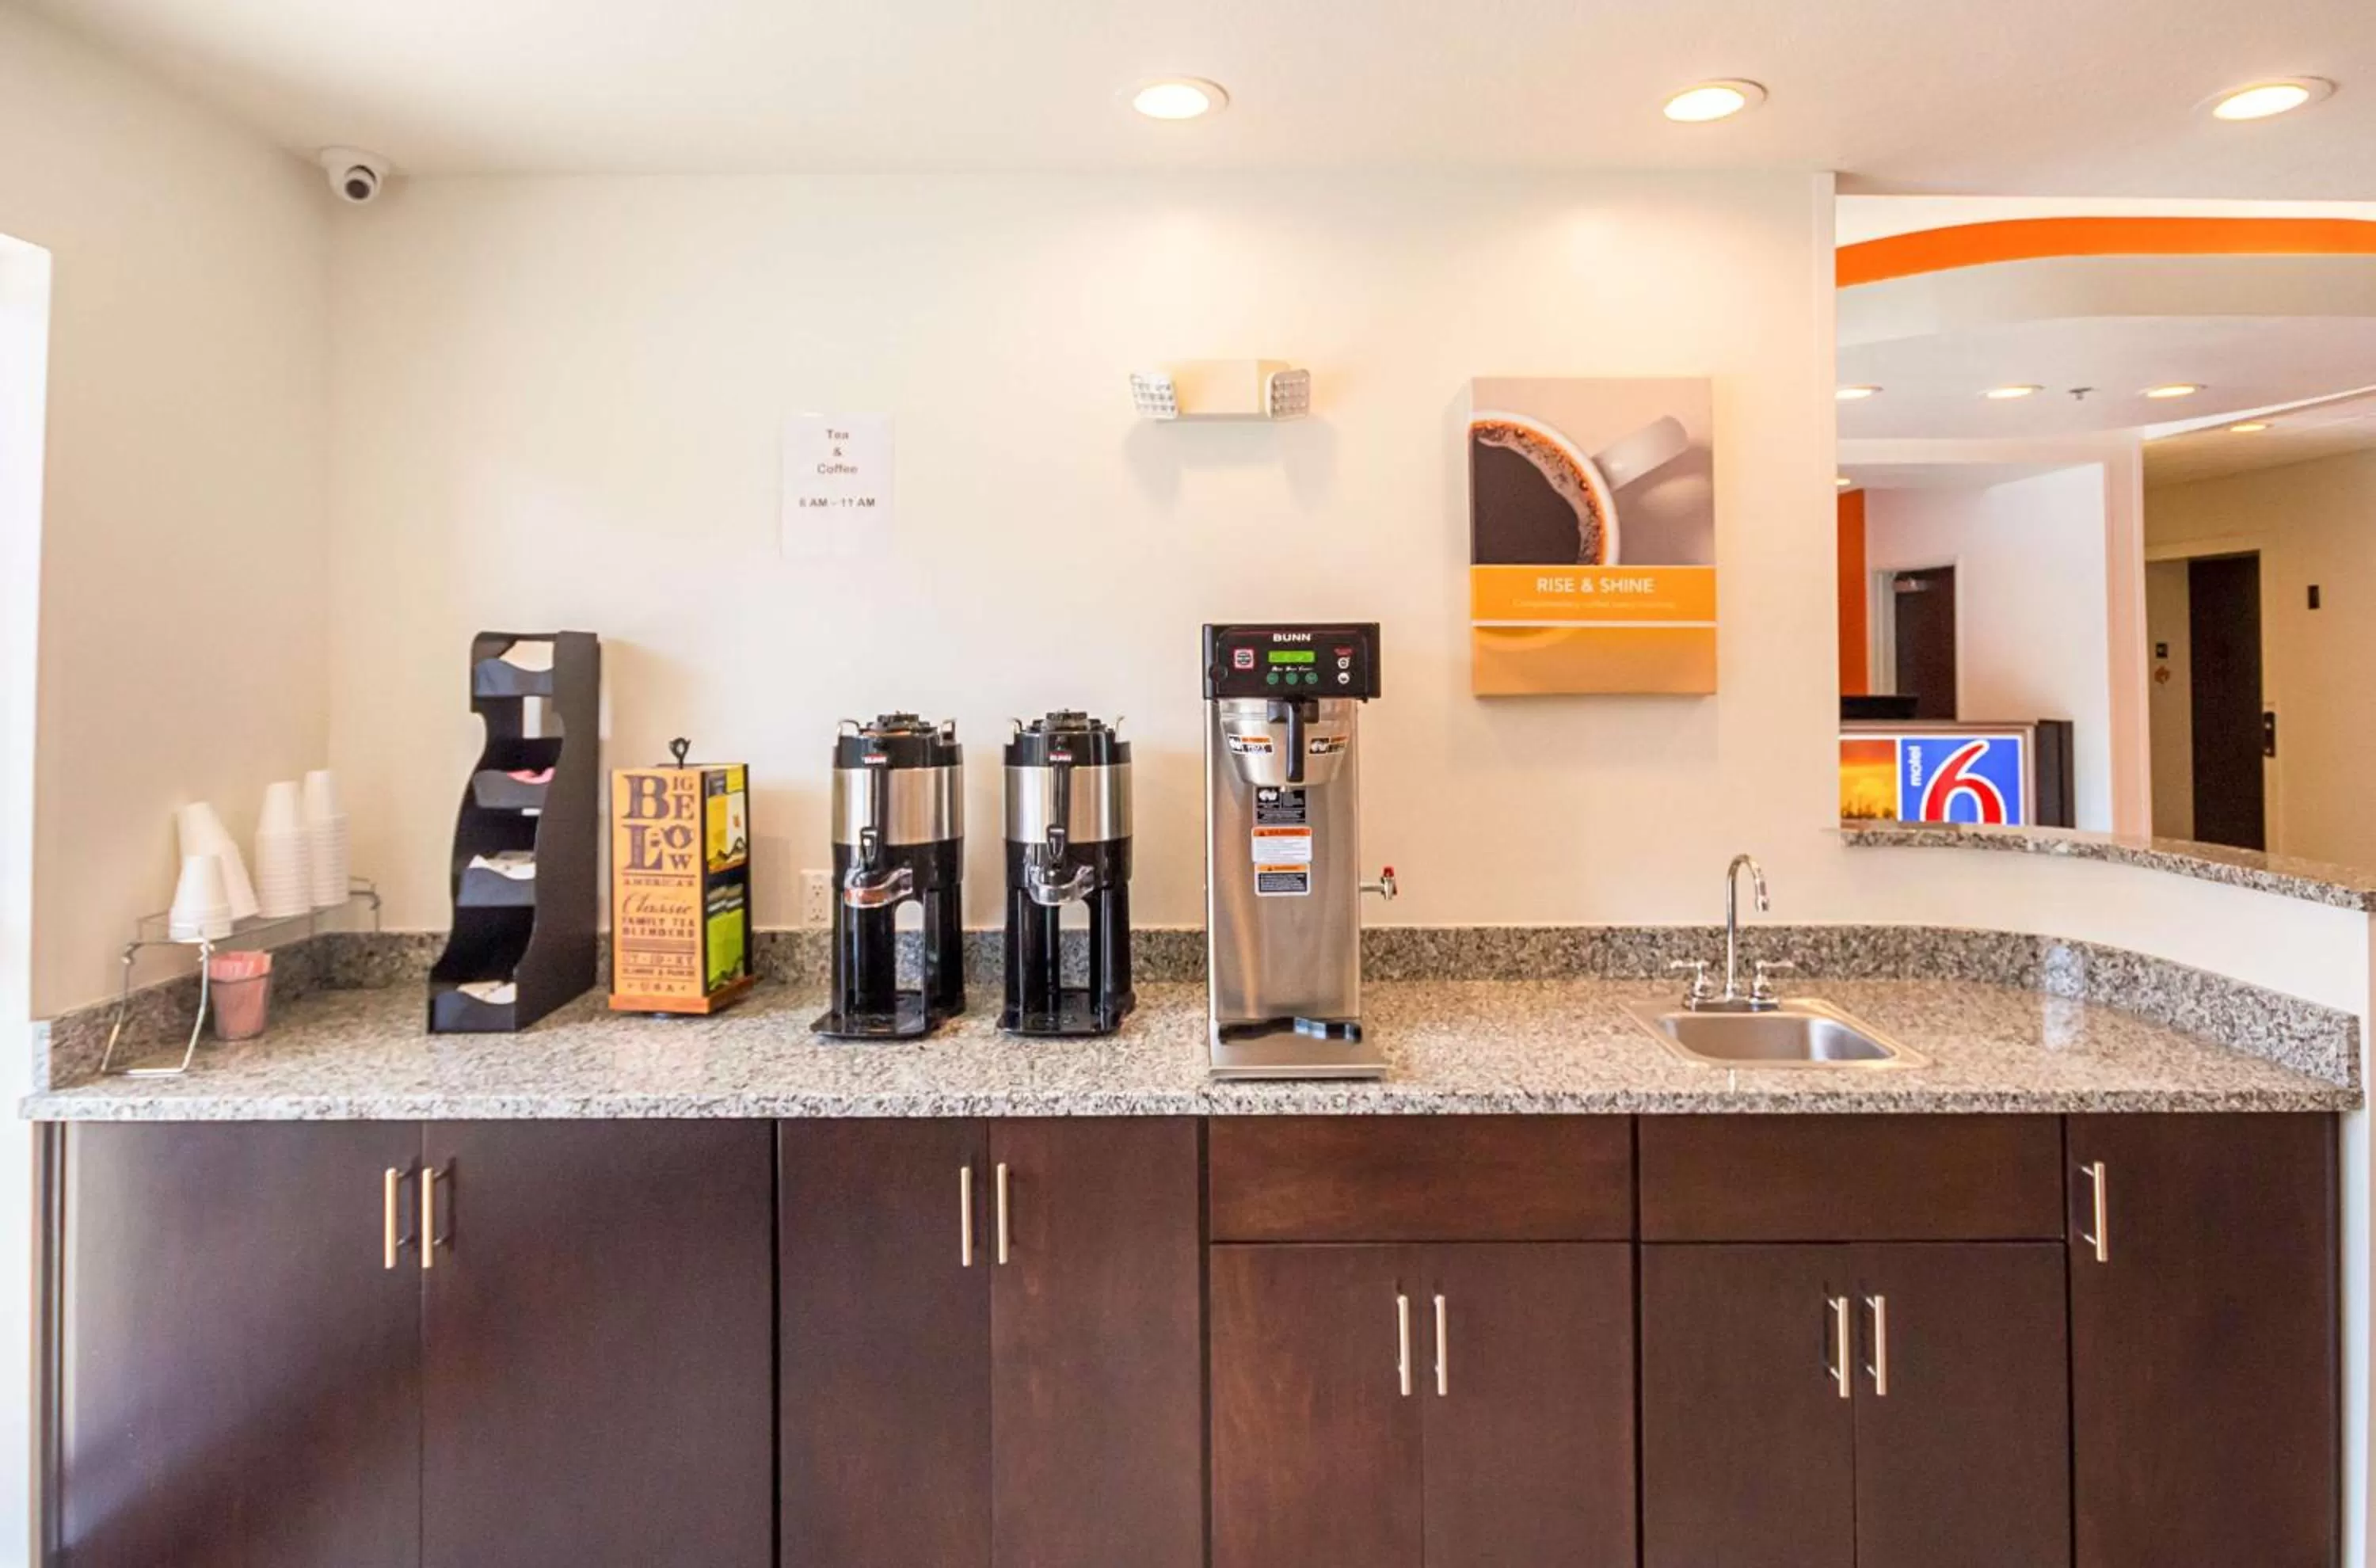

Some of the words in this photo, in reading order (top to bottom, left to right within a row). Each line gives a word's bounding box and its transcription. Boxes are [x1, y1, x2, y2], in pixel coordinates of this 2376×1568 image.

[826, 428, 849, 440] Tea
[832, 447, 842, 456] &
[817, 463, 859, 474] Coffee
[809, 497, 828, 508] AM
[857, 497, 875, 508] AM
[1536, 577, 1574, 593] RISE
[1581, 577, 1595, 593] &
[1600, 577, 1654, 594] SHINE
[1273, 634, 1312, 642] BUNN
[1909, 745, 1921, 786] motel
[1919, 739, 2008, 825] 6
